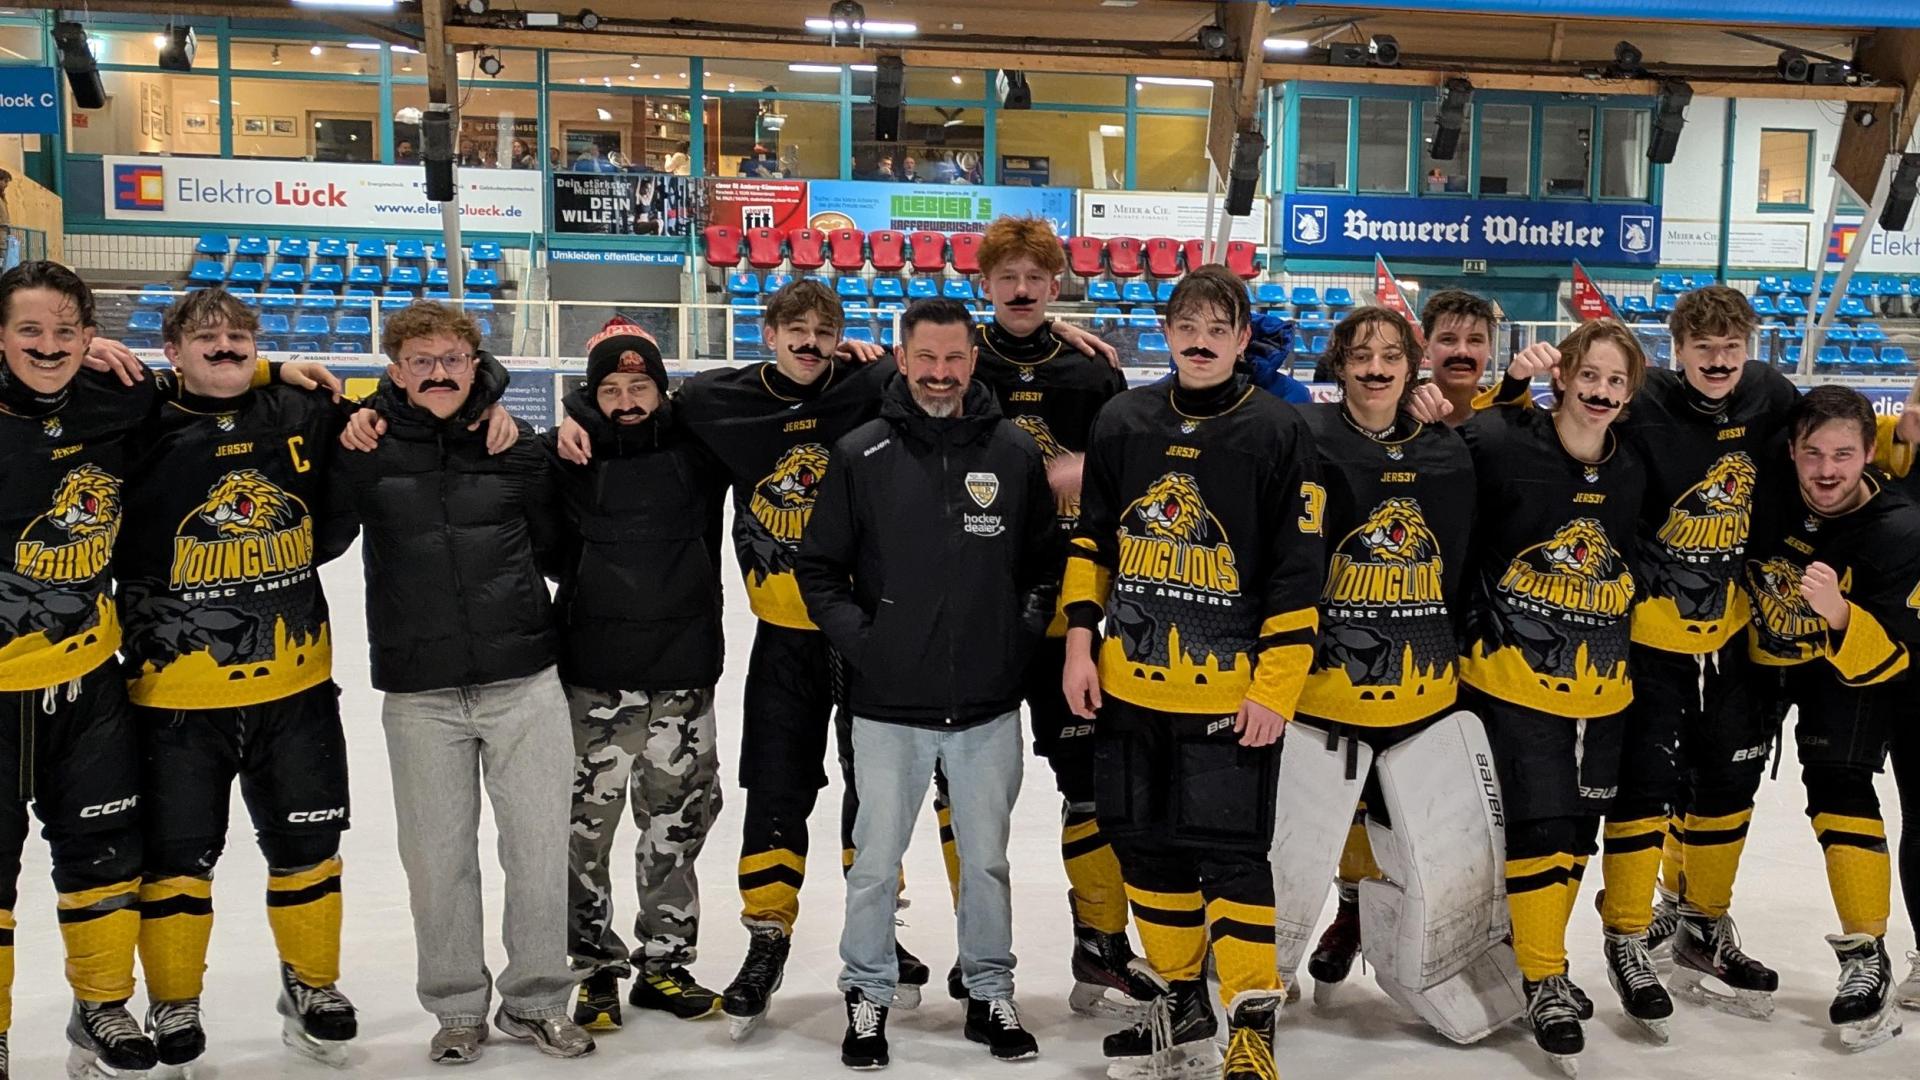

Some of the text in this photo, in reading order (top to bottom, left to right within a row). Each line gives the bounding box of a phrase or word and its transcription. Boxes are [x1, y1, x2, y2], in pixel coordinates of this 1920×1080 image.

[40, 93, 54, 107] C
[178, 178, 348, 207] ElektroLück
[557, 178, 631, 190] Dein stärkster
[590, 197, 630, 211] DEIN
[1343, 209, 1605, 247] Brauerei Winkler
[552, 250, 678, 263] Umkleiden öffentlicher Lauf
[288, 436, 310, 473] C
[964, 512, 1002, 527] hockey
[964, 521, 996, 533] dealer
[14, 533, 112, 584] YOUNG
[1118, 527, 1242, 597] OUNGLIONS
[183, 588, 237, 602] ERSC
[1156, 588, 1233, 607] AMBERG
[1328, 609, 1378, 619] ERSC
[1507, 597, 1552, 617] ERSC
[1475, 752, 1505, 828] BAUER
[80, 795, 140, 818] CCM
[287, 807, 345, 823] CCM
